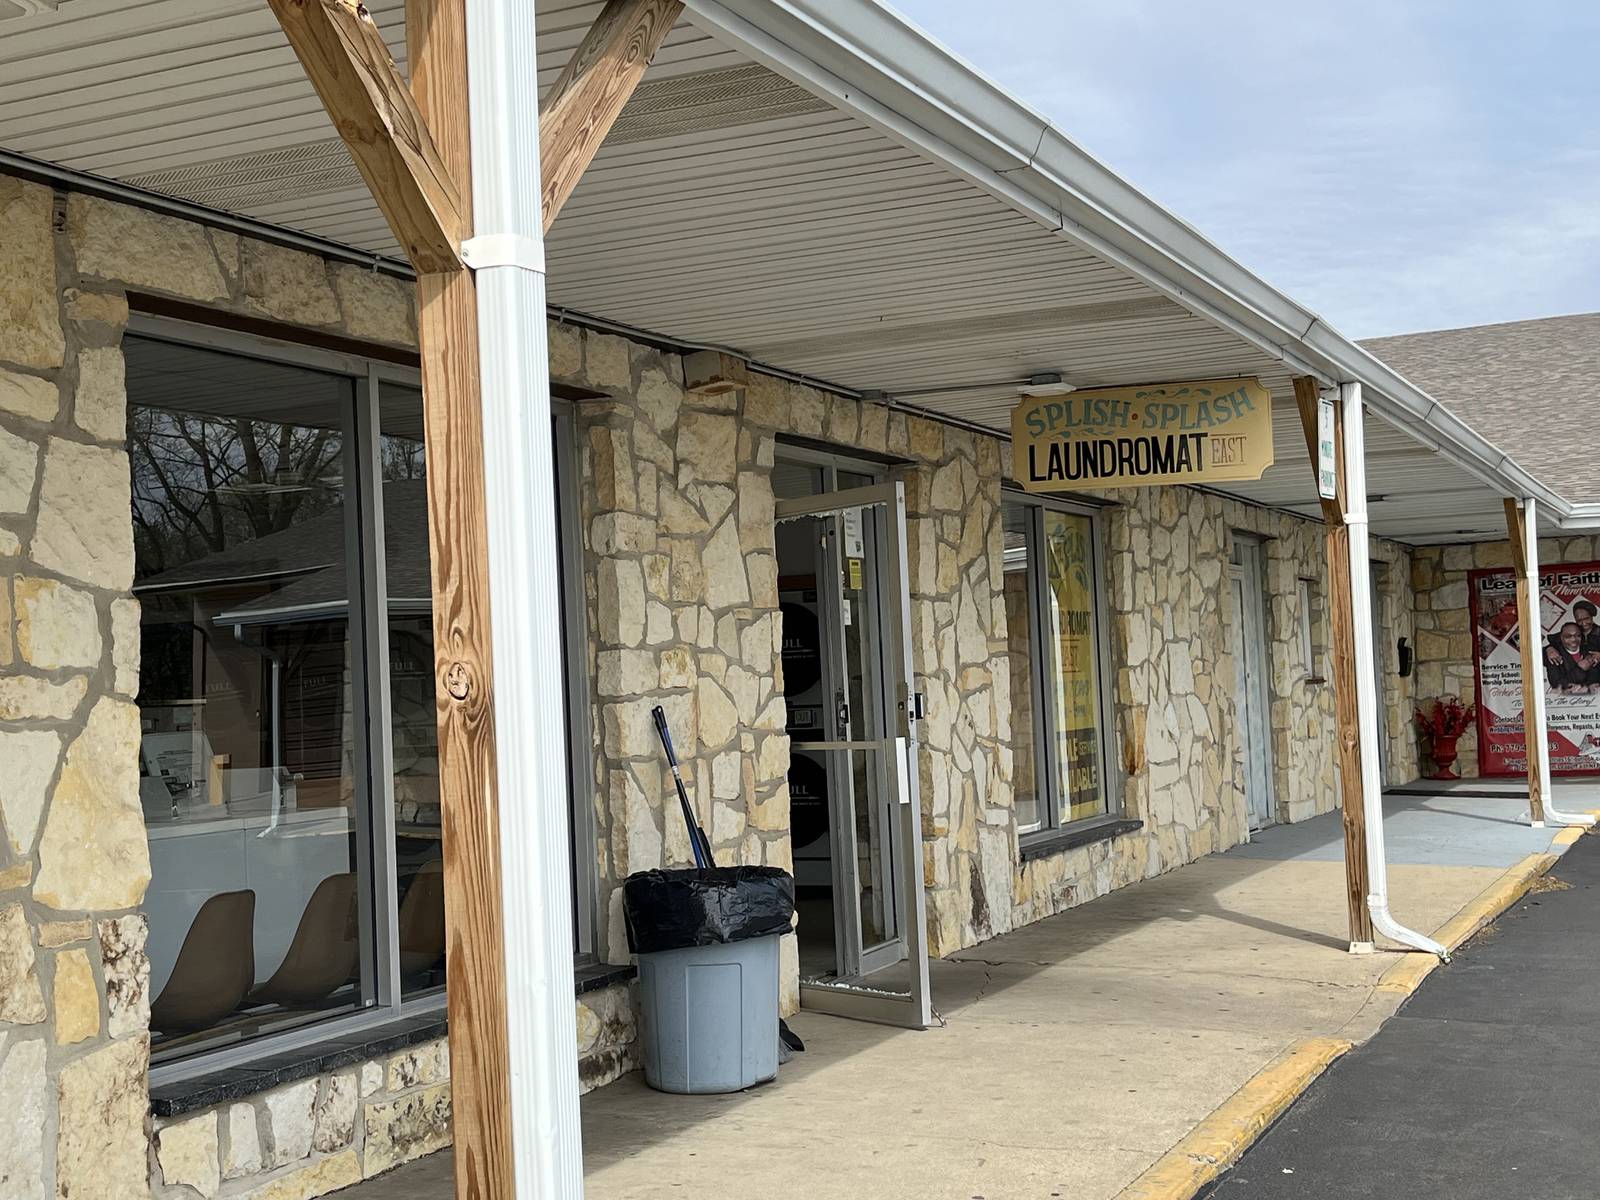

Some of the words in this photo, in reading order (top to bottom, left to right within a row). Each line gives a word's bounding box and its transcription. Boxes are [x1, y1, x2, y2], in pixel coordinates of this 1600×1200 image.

[1025, 399, 1131, 438] SPLISH
[1142, 386, 1255, 430] SPLASH
[1029, 433, 1208, 482] LAUNDROMAT
[1211, 436, 1247, 464] EAST
[1481, 578, 1516, 591] Lea
